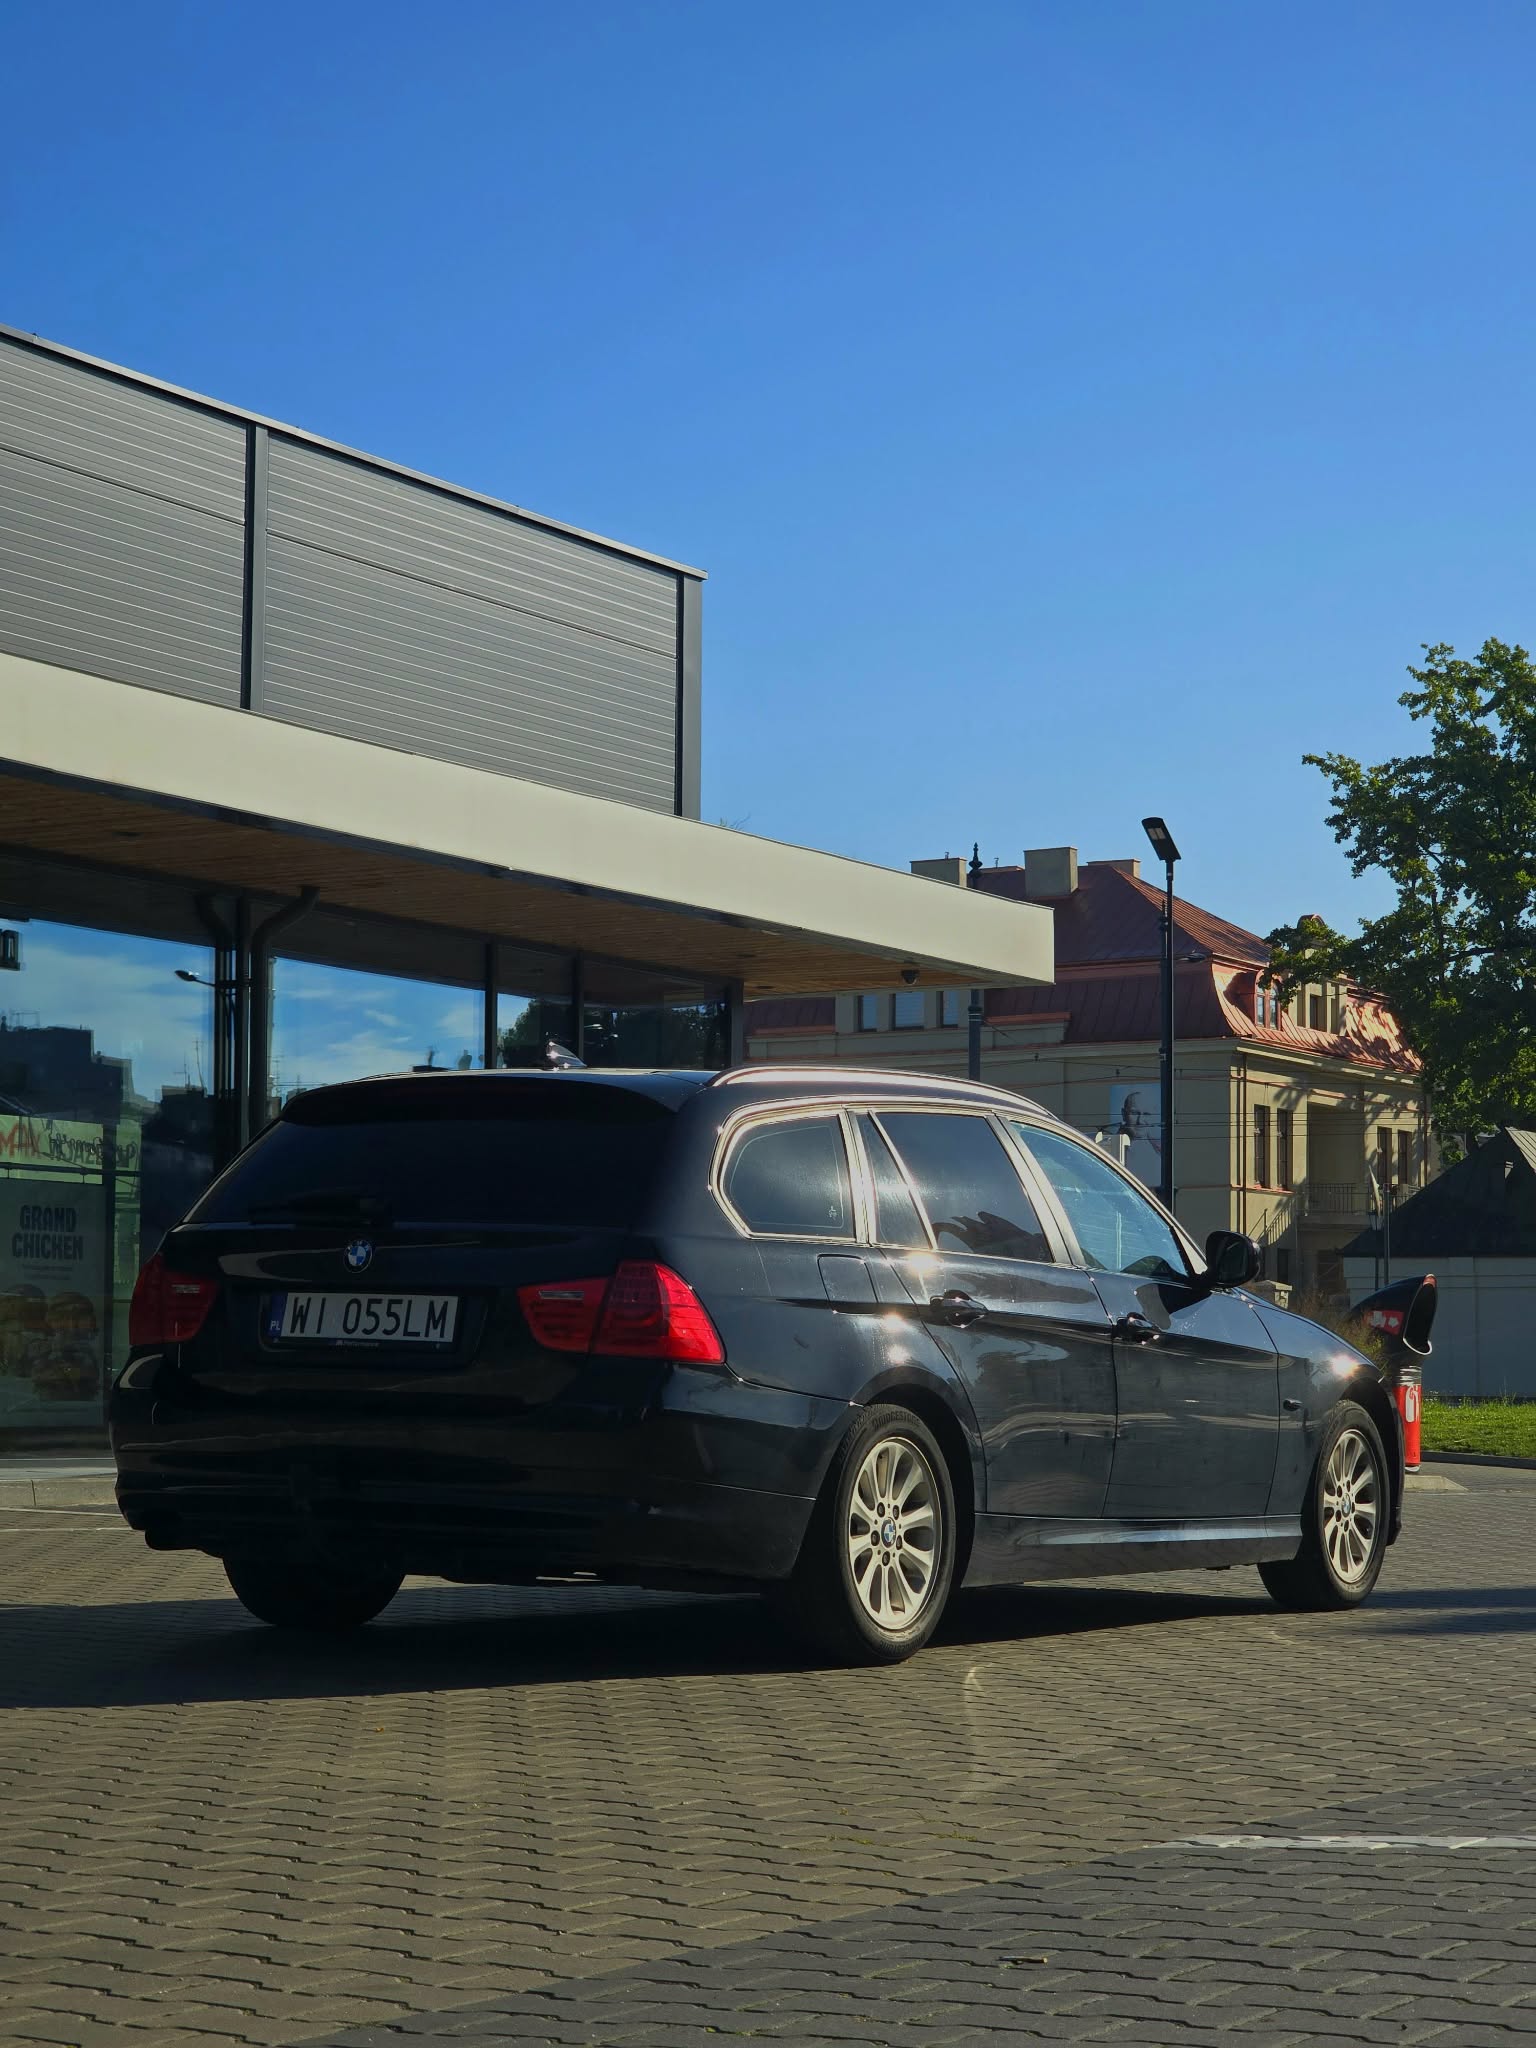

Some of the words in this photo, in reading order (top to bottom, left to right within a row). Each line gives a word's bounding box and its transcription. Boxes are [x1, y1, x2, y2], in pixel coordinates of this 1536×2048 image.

[20, 1205, 77, 1232] GRAND
[12, 1233, 83, 1260] CHICKEN
[270, 1320, 281, 1331] PL
[289, 1296, 327, 1334] WI
[342, 1298, 449, 1338] 055LM
